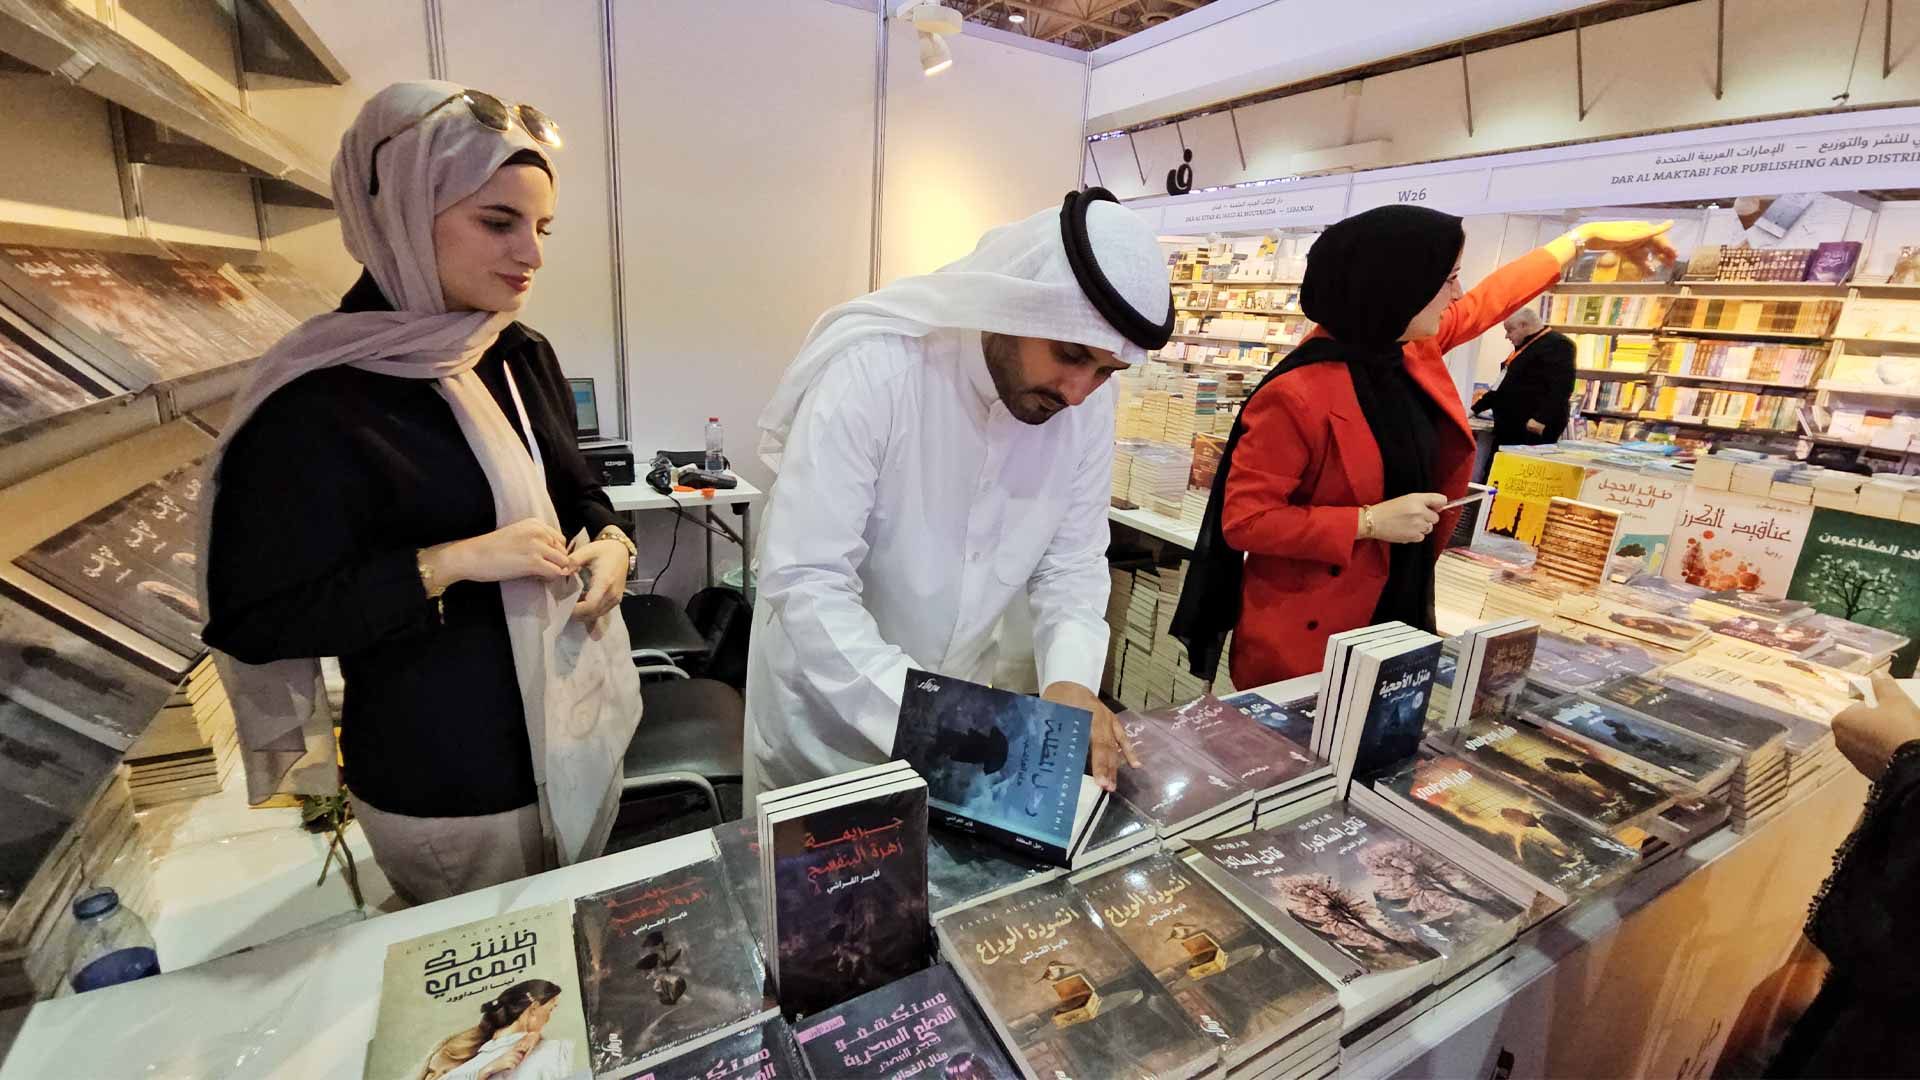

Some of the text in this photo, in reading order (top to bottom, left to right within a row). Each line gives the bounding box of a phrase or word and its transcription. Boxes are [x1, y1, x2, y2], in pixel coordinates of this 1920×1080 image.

[1818, 136, 1869, 154] والتوزيع
[1872, 133, 1910, 148] للنشر
[1655, 151, 1696, 165] المتحدة
[1697, 146, 1734, 163] العربية
[1610, 174, 1634, 185] DAR
[1635, 172, 1650, 183] AL
[1652, 168, 1710, 181] MAKTABI
[1712, 164, 1739, 177] FOR
[1740, 156, 1827, 174] PUBLISHING
[1829, 155, 1864, 167] AND
[1398, 187, 1427, 202] W26
[1599, 478, 1673, 500] طائر الحجل
[1679, 503, 1793, 543] عناقيد الكرز
[1817, 531, 1900, 556] المشاغبون
[424, 928, 538, 976] ظننتك
[975, 923, 1025, 966] الوداع
[425, 946, 536, 999] اجمعي
[842, 1027, 911, 1068] السحرية
